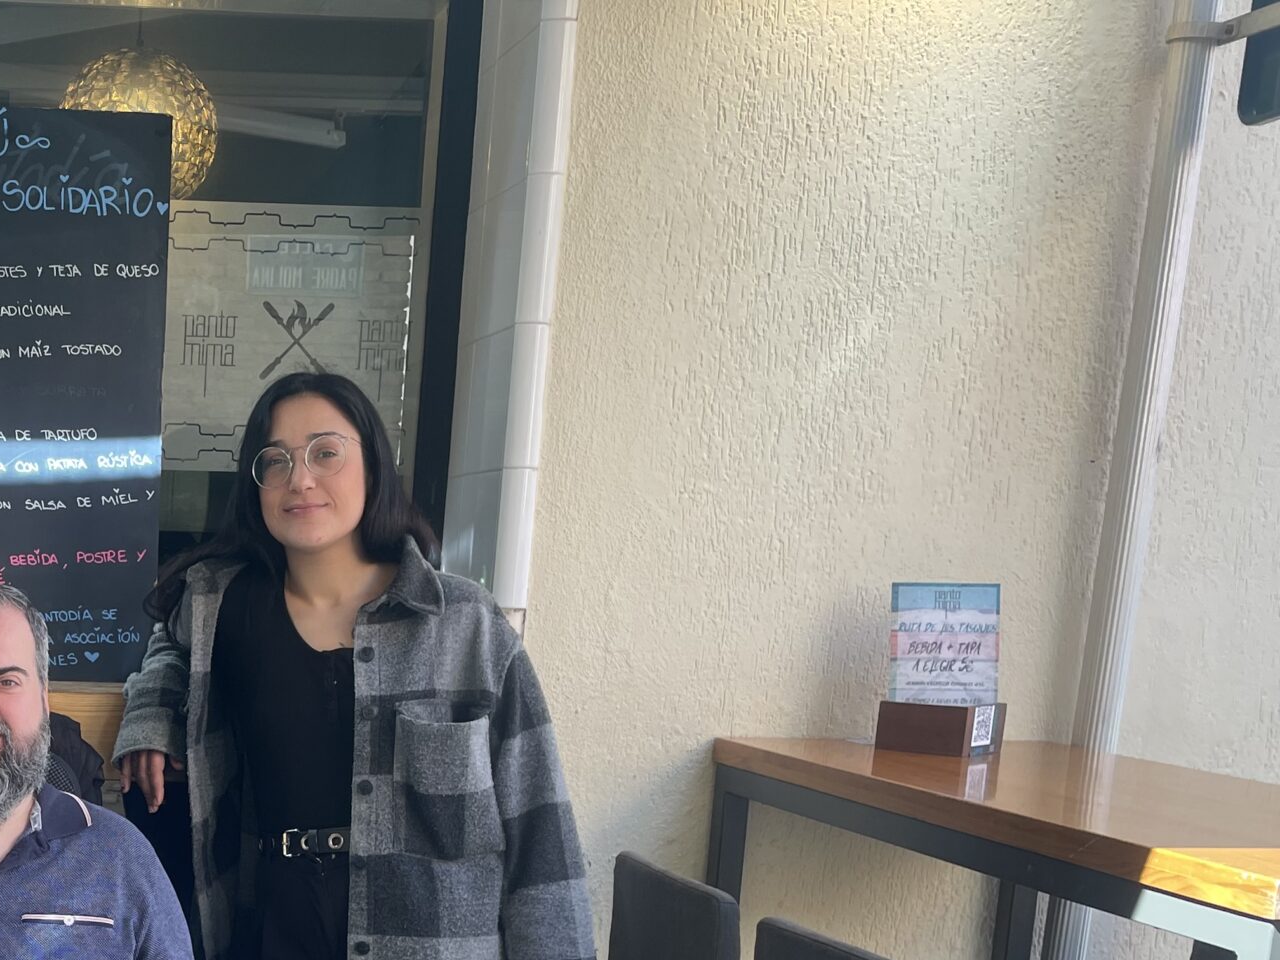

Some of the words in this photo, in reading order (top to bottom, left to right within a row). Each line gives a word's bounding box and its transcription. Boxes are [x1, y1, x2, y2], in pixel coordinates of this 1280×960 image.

[2, 174, 154, 217] SOLIDARIO
[37, 266, 43, 277] Y
[49, 264, 81, 277] TEJA
[94, 263, 109, 277] DE
[116, 263, 159, 278] QUESO
[61, 344, 122, 356] TOSTADO
[15, 429, 31, 441] DE
[41, 427, 97, 442] TARTUFO
[15, 460, 39, 474] CON
[46, 457, 88, 471] PATATA
[97, 449, 153, 468] RÚSTICA
[25, 499, 66, 511] SALSA
[76, 496, 92, 508] DE
[101, 487, 138, 506] MIEL
[145, 489, 155, 501] Y
[76, 549, 127, 564] POSTRE
[137, 549, 147, 562] Y
[102, 608, 117, 621] SE
[64, 625, 140, 645] ASOCIACIÓN
[907, 640, 943, 655] BEBIDA
[957, 641, 982, 655] TAPA
